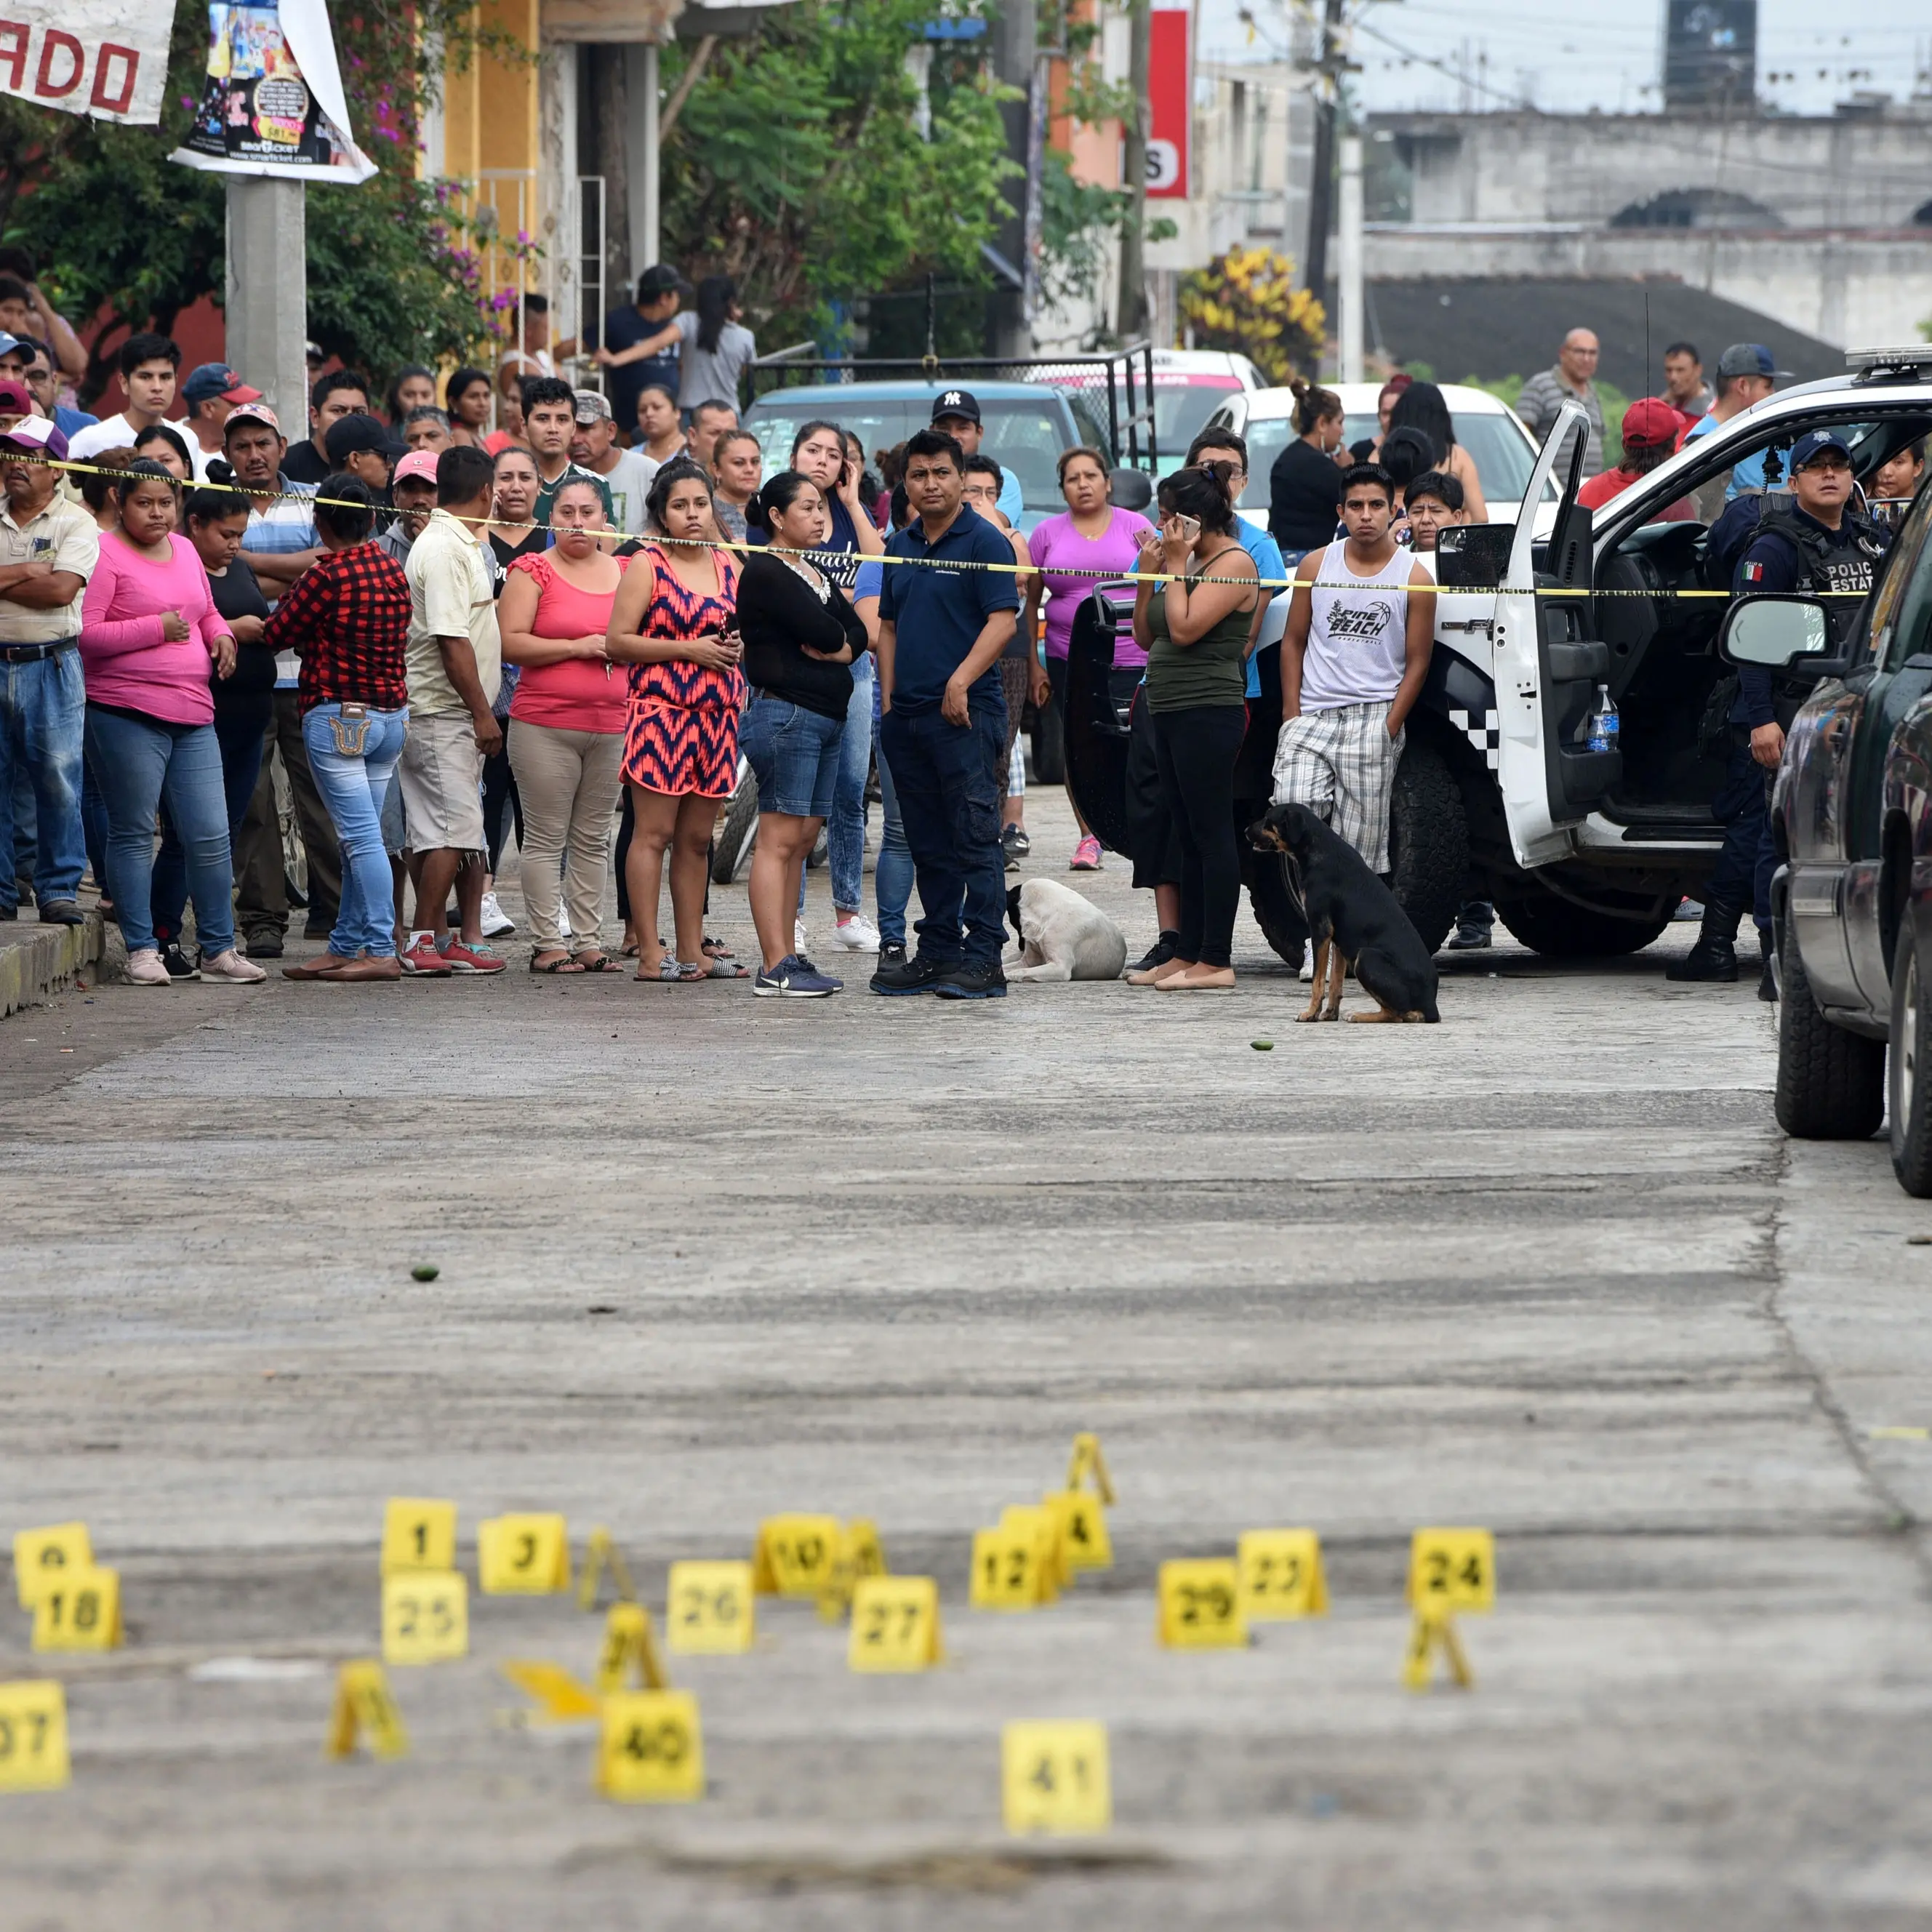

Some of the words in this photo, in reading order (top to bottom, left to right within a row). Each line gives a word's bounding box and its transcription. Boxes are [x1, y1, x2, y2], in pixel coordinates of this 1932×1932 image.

[1827, 561, 1872, 579] POLIC
[1830, 575, 1874, 593] ESTAT
[1328, 618, 1386, 636] BEACH
[1342, 609, 1379, 621] PINE
[412, 1522, 428, 1562] 1
[985, 1547, 1027, 1590] 12
[1427, 1550, 1481, 1592] 24
[1028, 1751, 1091, 1796] 41
